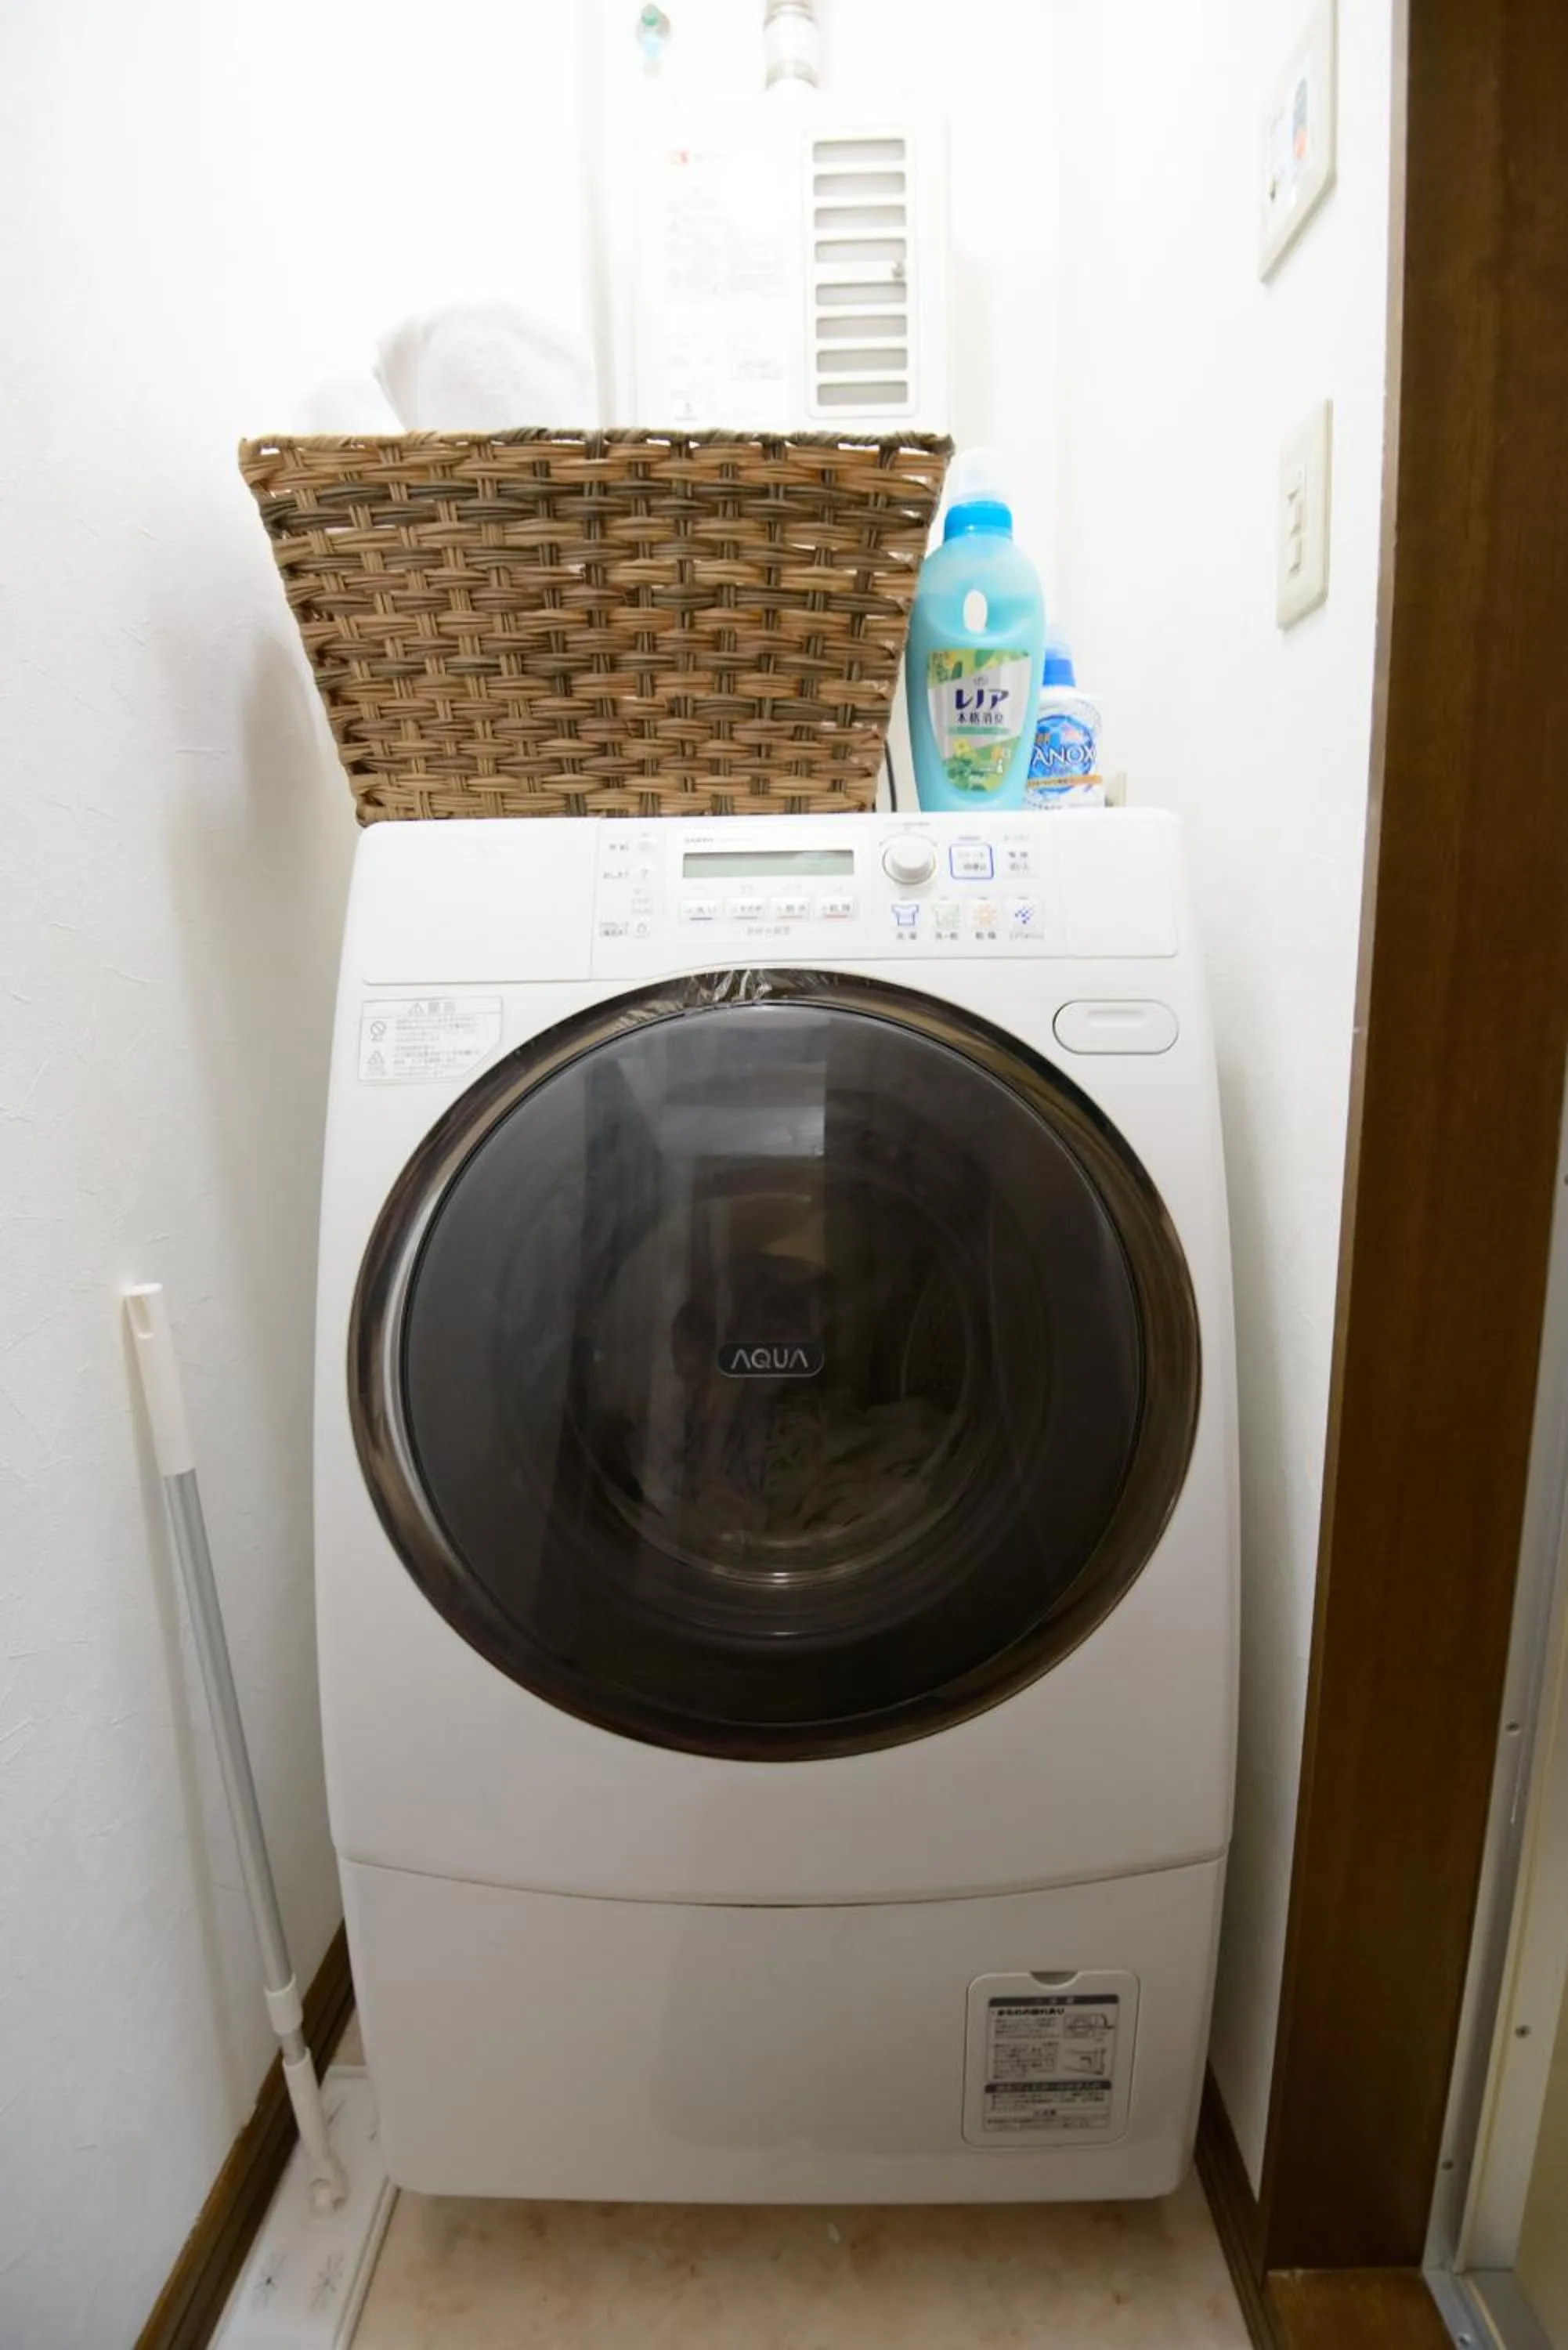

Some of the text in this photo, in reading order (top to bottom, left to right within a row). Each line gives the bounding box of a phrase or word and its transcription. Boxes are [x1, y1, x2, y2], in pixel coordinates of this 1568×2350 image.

[955, 689, 1010, 710] レノア
[1031, 744, 1097, 767] ANOX
[730, 1348, 808, 1369] AQUA
